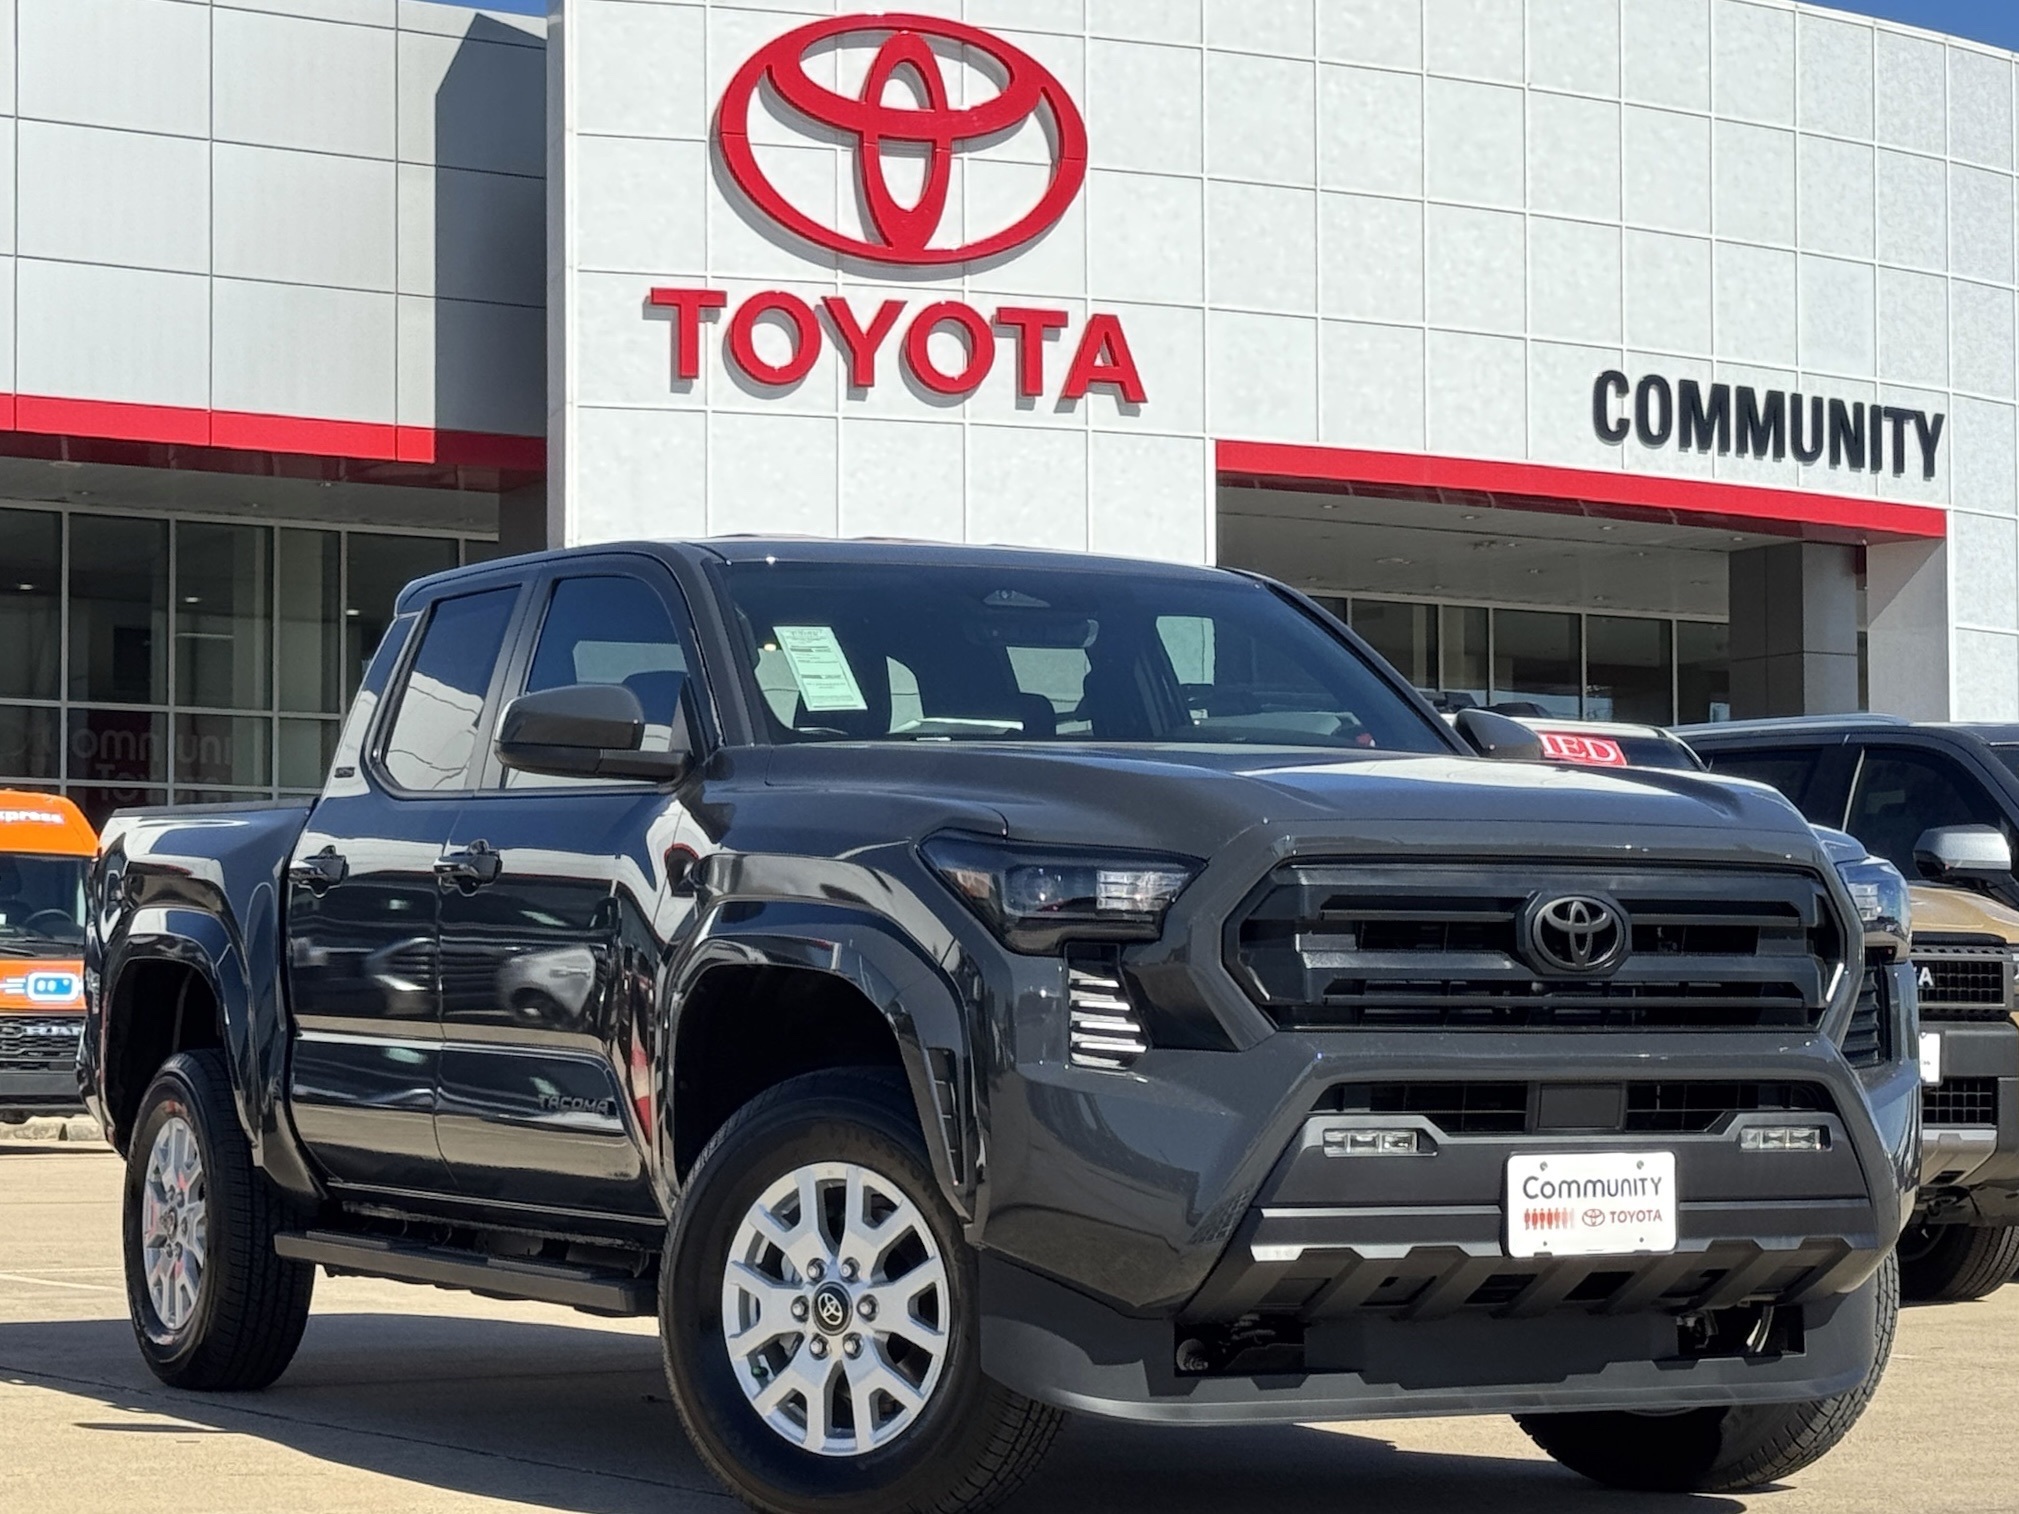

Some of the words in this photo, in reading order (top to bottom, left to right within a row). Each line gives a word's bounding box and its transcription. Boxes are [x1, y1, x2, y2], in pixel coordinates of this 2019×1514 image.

[650, 287, 1148, 404] TOYOTA
[1592, 370, 1945, 479] COMMUNITY
[538, 1094, 609, 1115] TACOMA
[1610, 1209, 1663, 1224] TOYOTA
